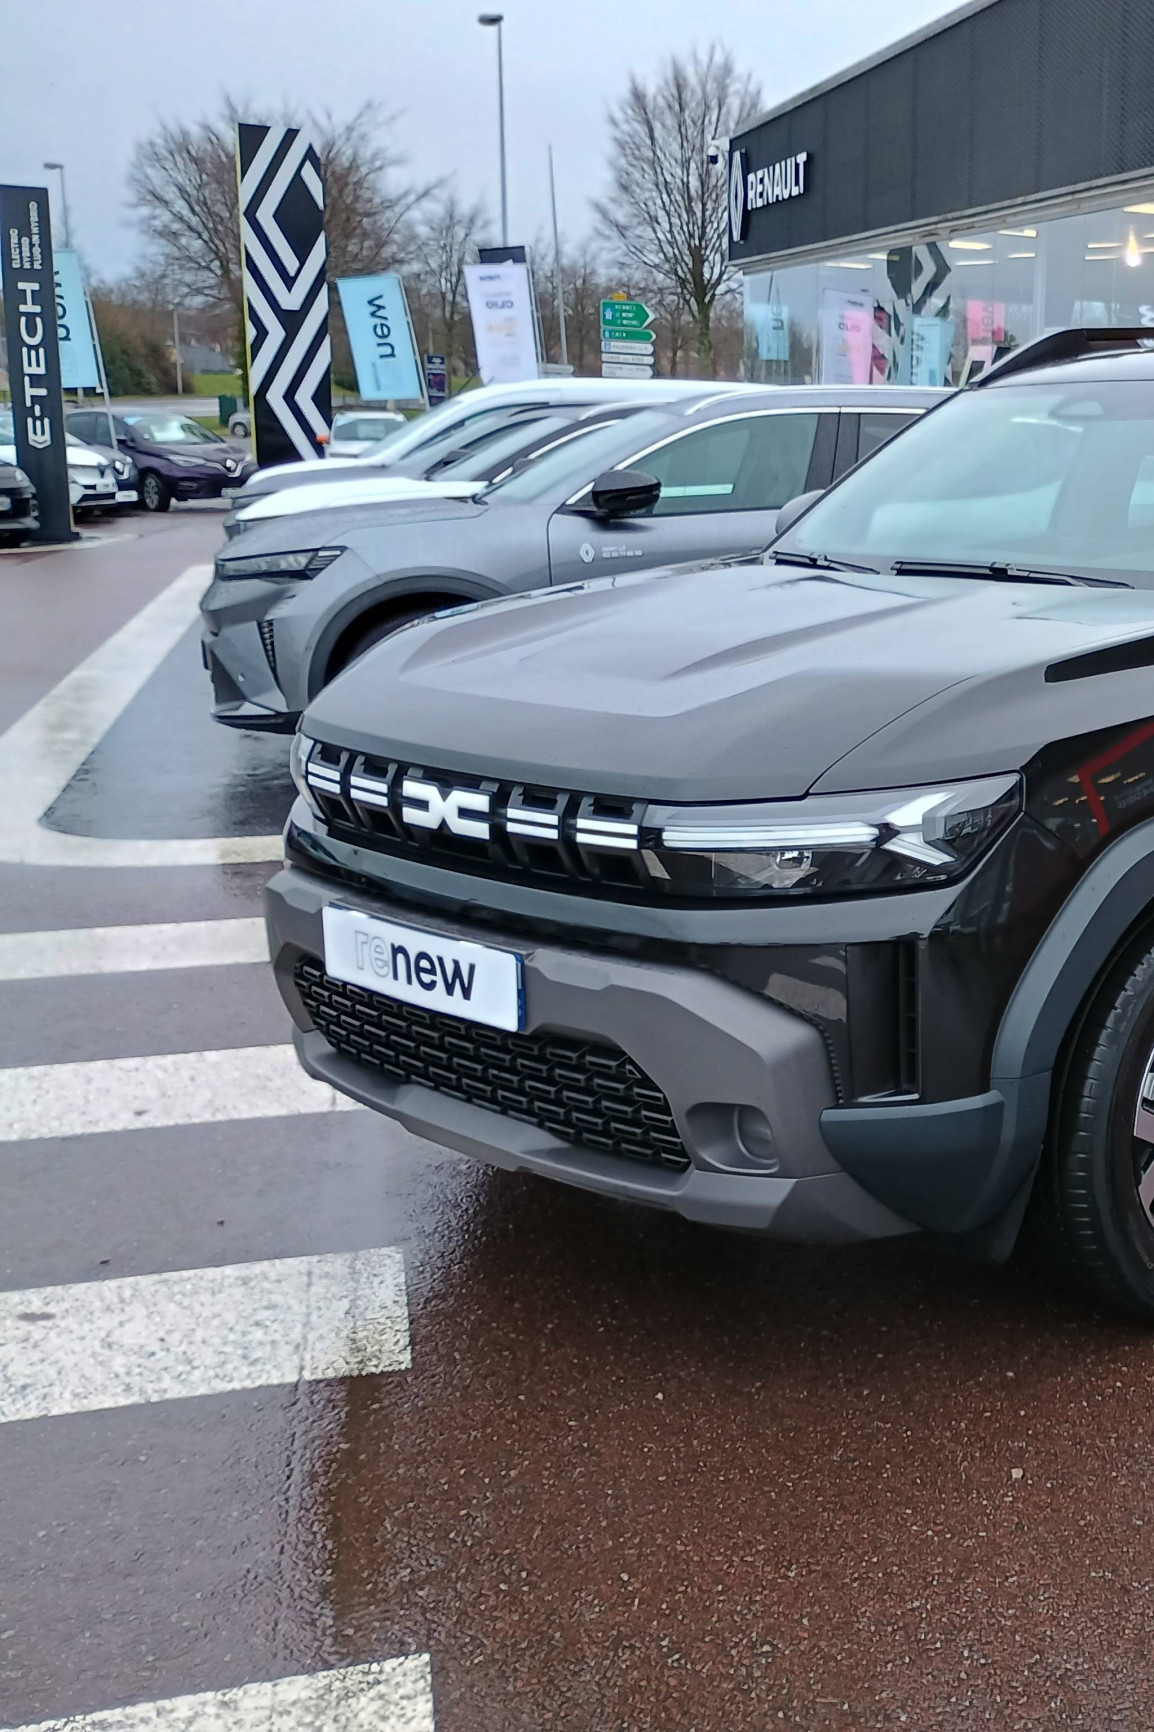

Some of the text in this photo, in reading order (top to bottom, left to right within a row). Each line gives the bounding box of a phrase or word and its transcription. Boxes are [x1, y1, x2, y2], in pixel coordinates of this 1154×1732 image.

[747, 151, 807, 211] RENAULT
[17, 282, 51, 449] E-TECH
[353, 929, 476, 1002] renew
